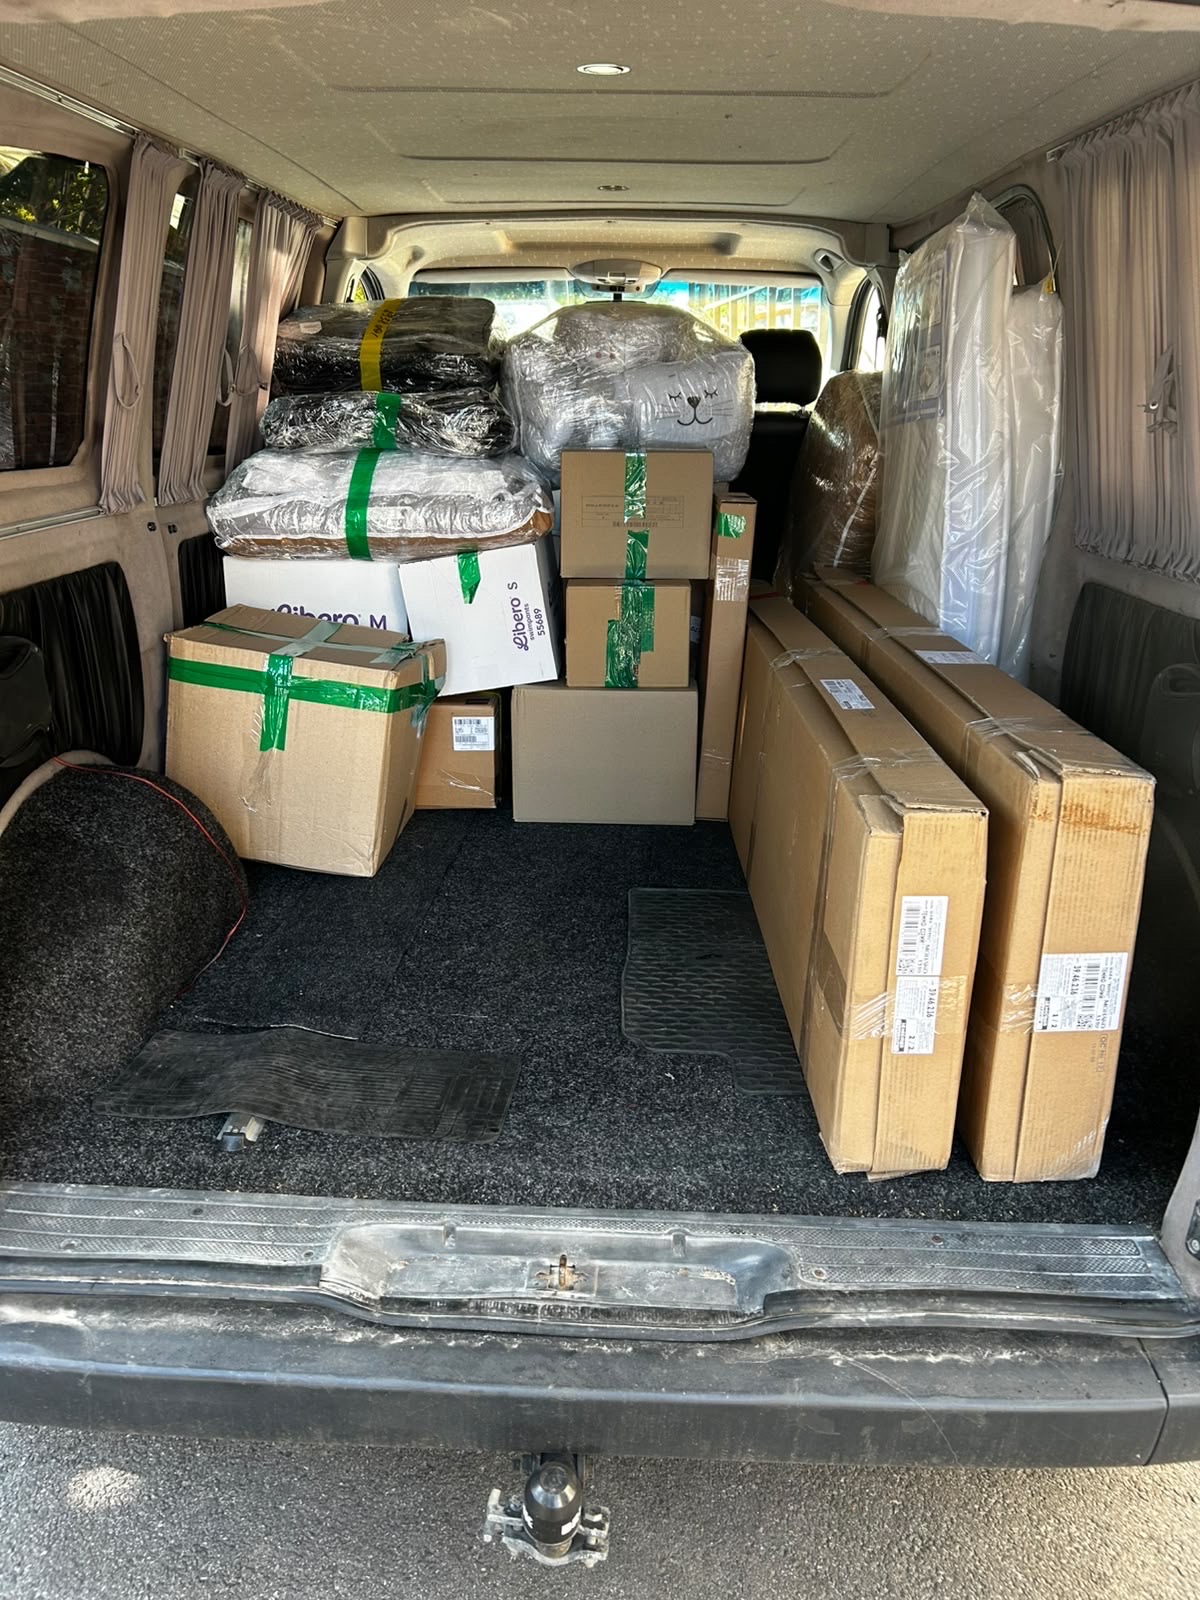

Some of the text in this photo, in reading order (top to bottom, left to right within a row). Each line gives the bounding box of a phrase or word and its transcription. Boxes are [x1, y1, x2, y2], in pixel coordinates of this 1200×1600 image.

[370, 614, 387, 631] M
[507, 581, 530, 651] Libero S
[524, 603, 535, 641] swimpants
[533, 608, 546, 636] 55689
